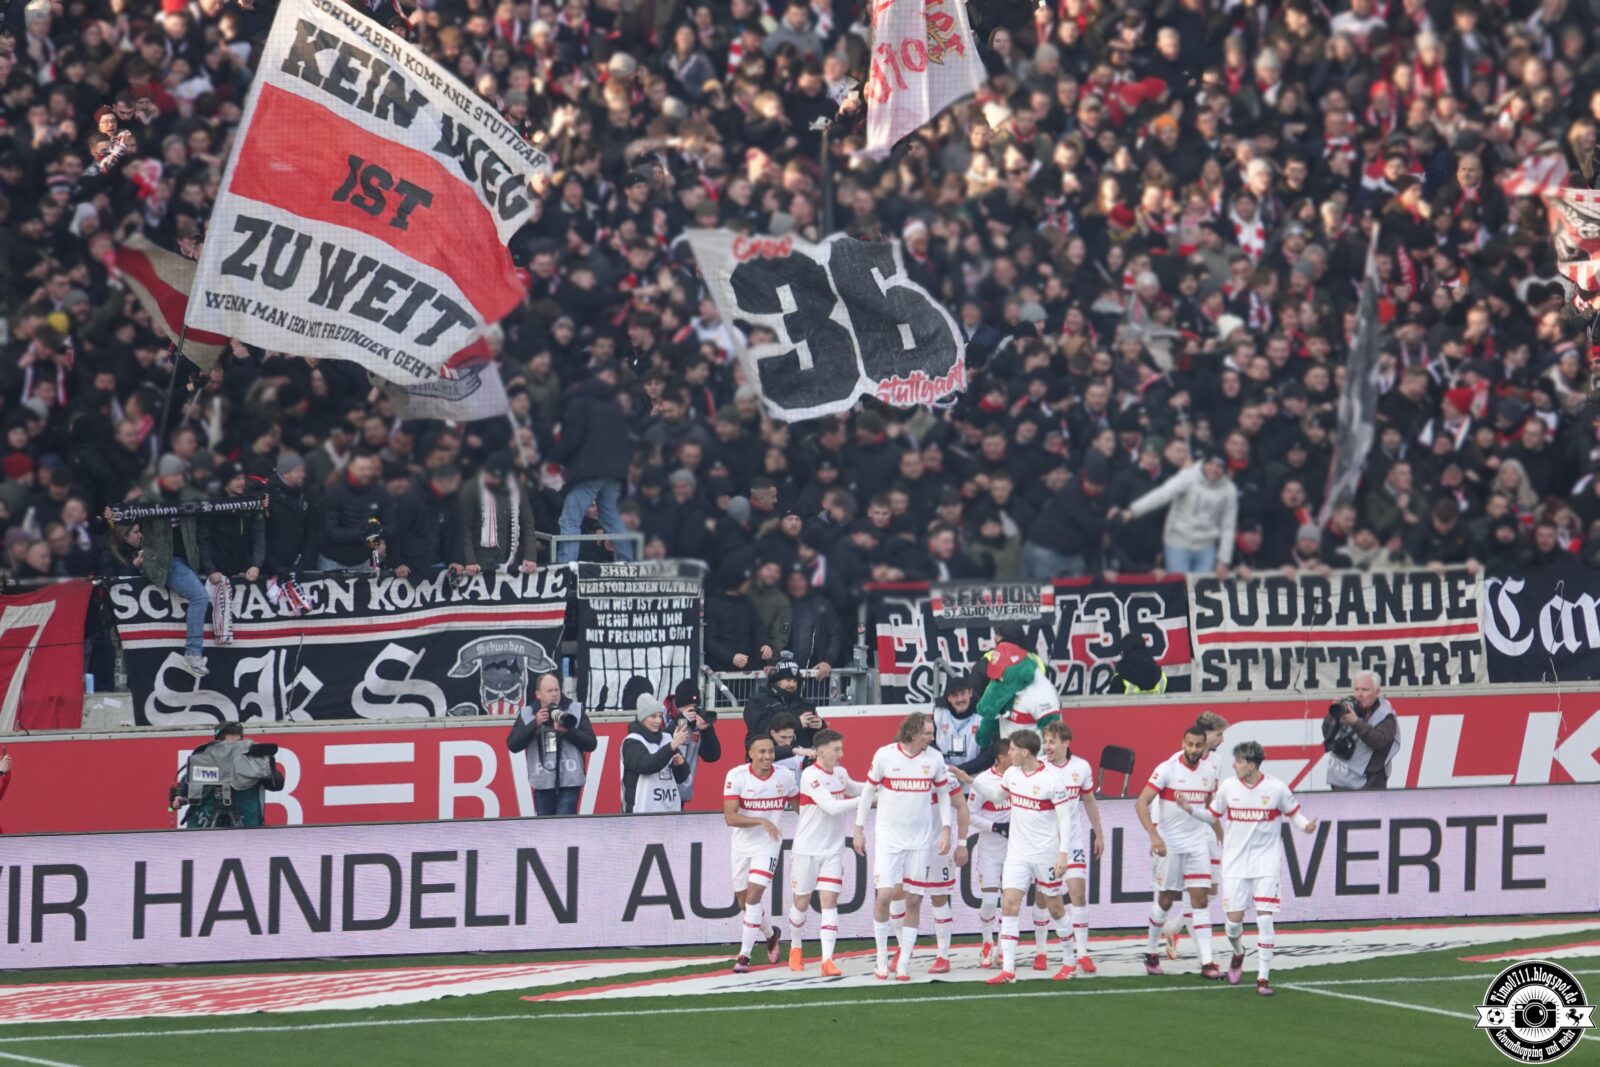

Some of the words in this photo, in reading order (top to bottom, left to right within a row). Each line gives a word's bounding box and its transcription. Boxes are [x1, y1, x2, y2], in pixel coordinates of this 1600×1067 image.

[403, 51, 472, 114] KOMPANIE
[281, 18, 430, 130] KEIN
[433, 113, 531, 221] WEG
[331, 154, 434, 231] IST
[221, 214, 313, 291] ZU
[307, 241, 477, 348] WEIT
[205, 291, 252, 313] WENN
[252, 301, 289, 331] MAN
[321, 322, 395, 360] FREUNDEN
[393, 350, 439, 380] GEHT
[730, 237, 958, 410] 36
[580, 581, 657, 594] VERSTORBENEN
[660, 581, 698, 594] ULTRAS
[600, 565, 638, 578] EHRE
[586, 628, 605, 643] MIT
[608, 629, 666, 644] FREUNDEN
[597, 613, 629, 628] WENN
[633, 612, 658, 628] MAN
[662, 612, 683, 626] IHN
[1201, 639, 1482, 692] STUTTGART
[743, 799, 784, 810] WINAMAX
[890, 779, 931, 791] WINAMAX
[0, 863, 89, 944] IR
[132, 846, 580, 941] HANDELN
